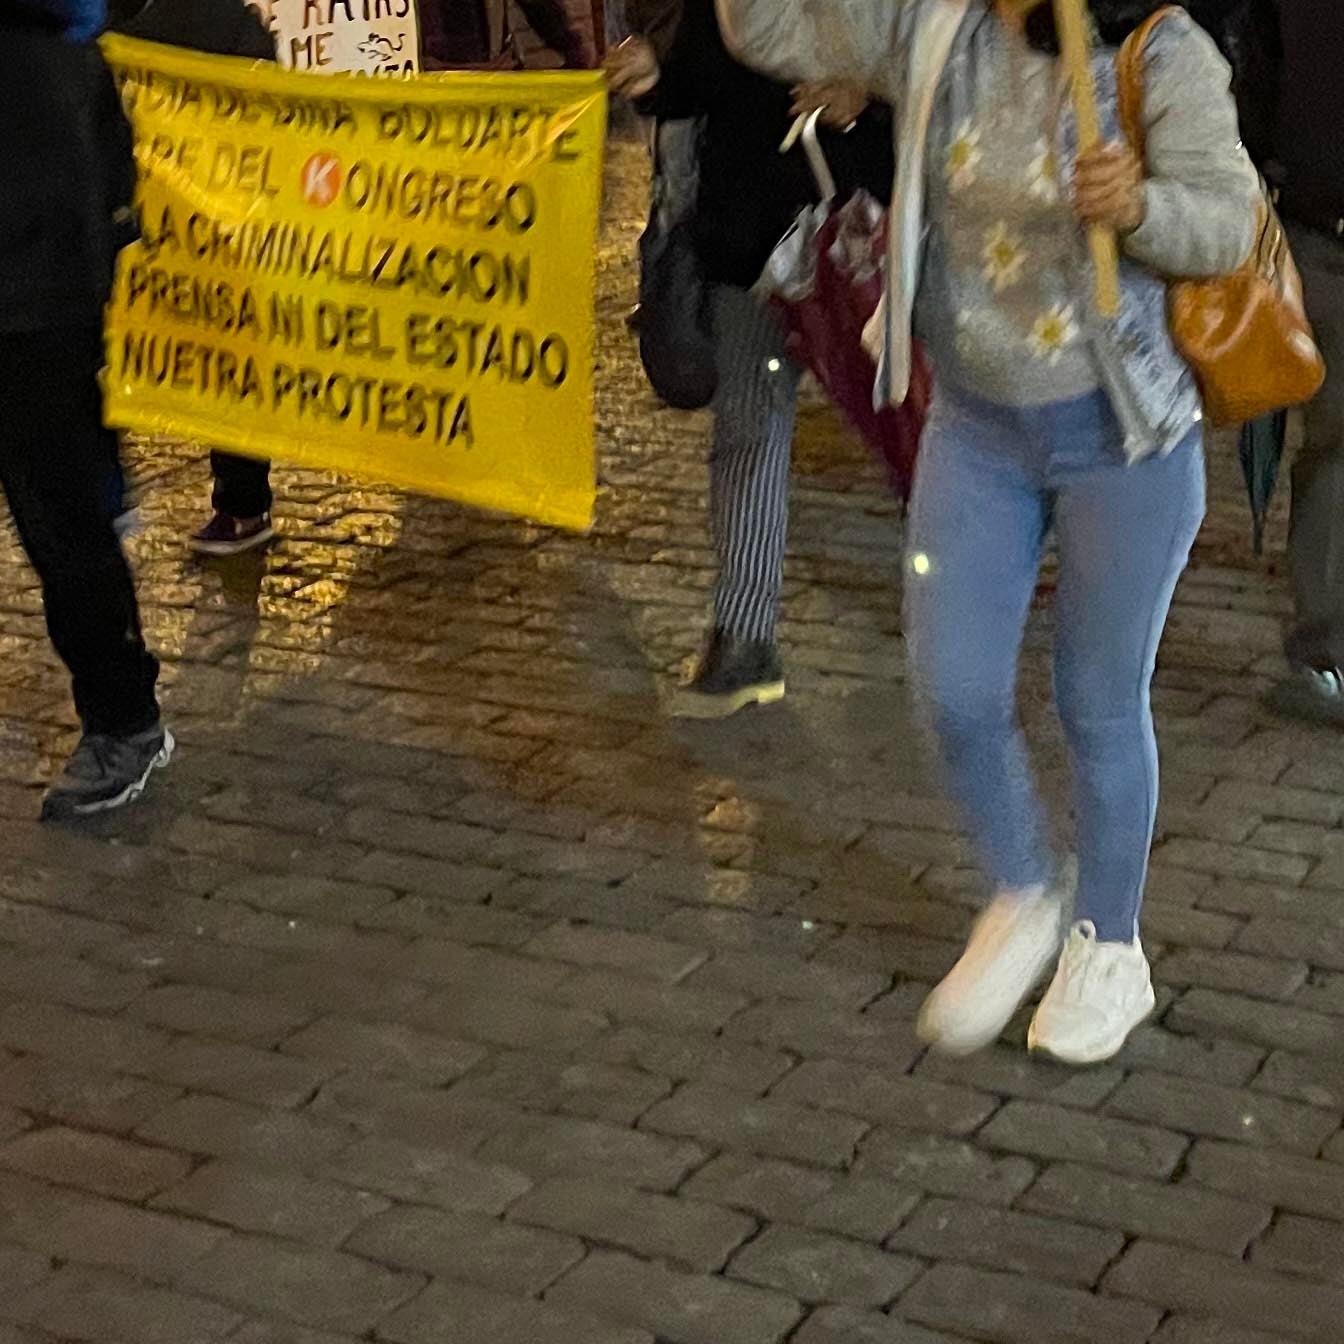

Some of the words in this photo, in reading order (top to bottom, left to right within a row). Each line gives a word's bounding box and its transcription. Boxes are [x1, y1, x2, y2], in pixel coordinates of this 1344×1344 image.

[210, 141, 281, 197] DEL
[302, 153, 536, 233] KONGRESO
[188, 213, 530, 306] CRIMINALIZACION
[127, 263, 262, 340] PRENSA
[268, 292, 304, 348] NI
[316, 300, 396, 361] DEL
[407, 312, 568, 388] ESTADO
[121, 330, 264, 407] NUETRA
[272, 362, 474, 448] PROTESTA
